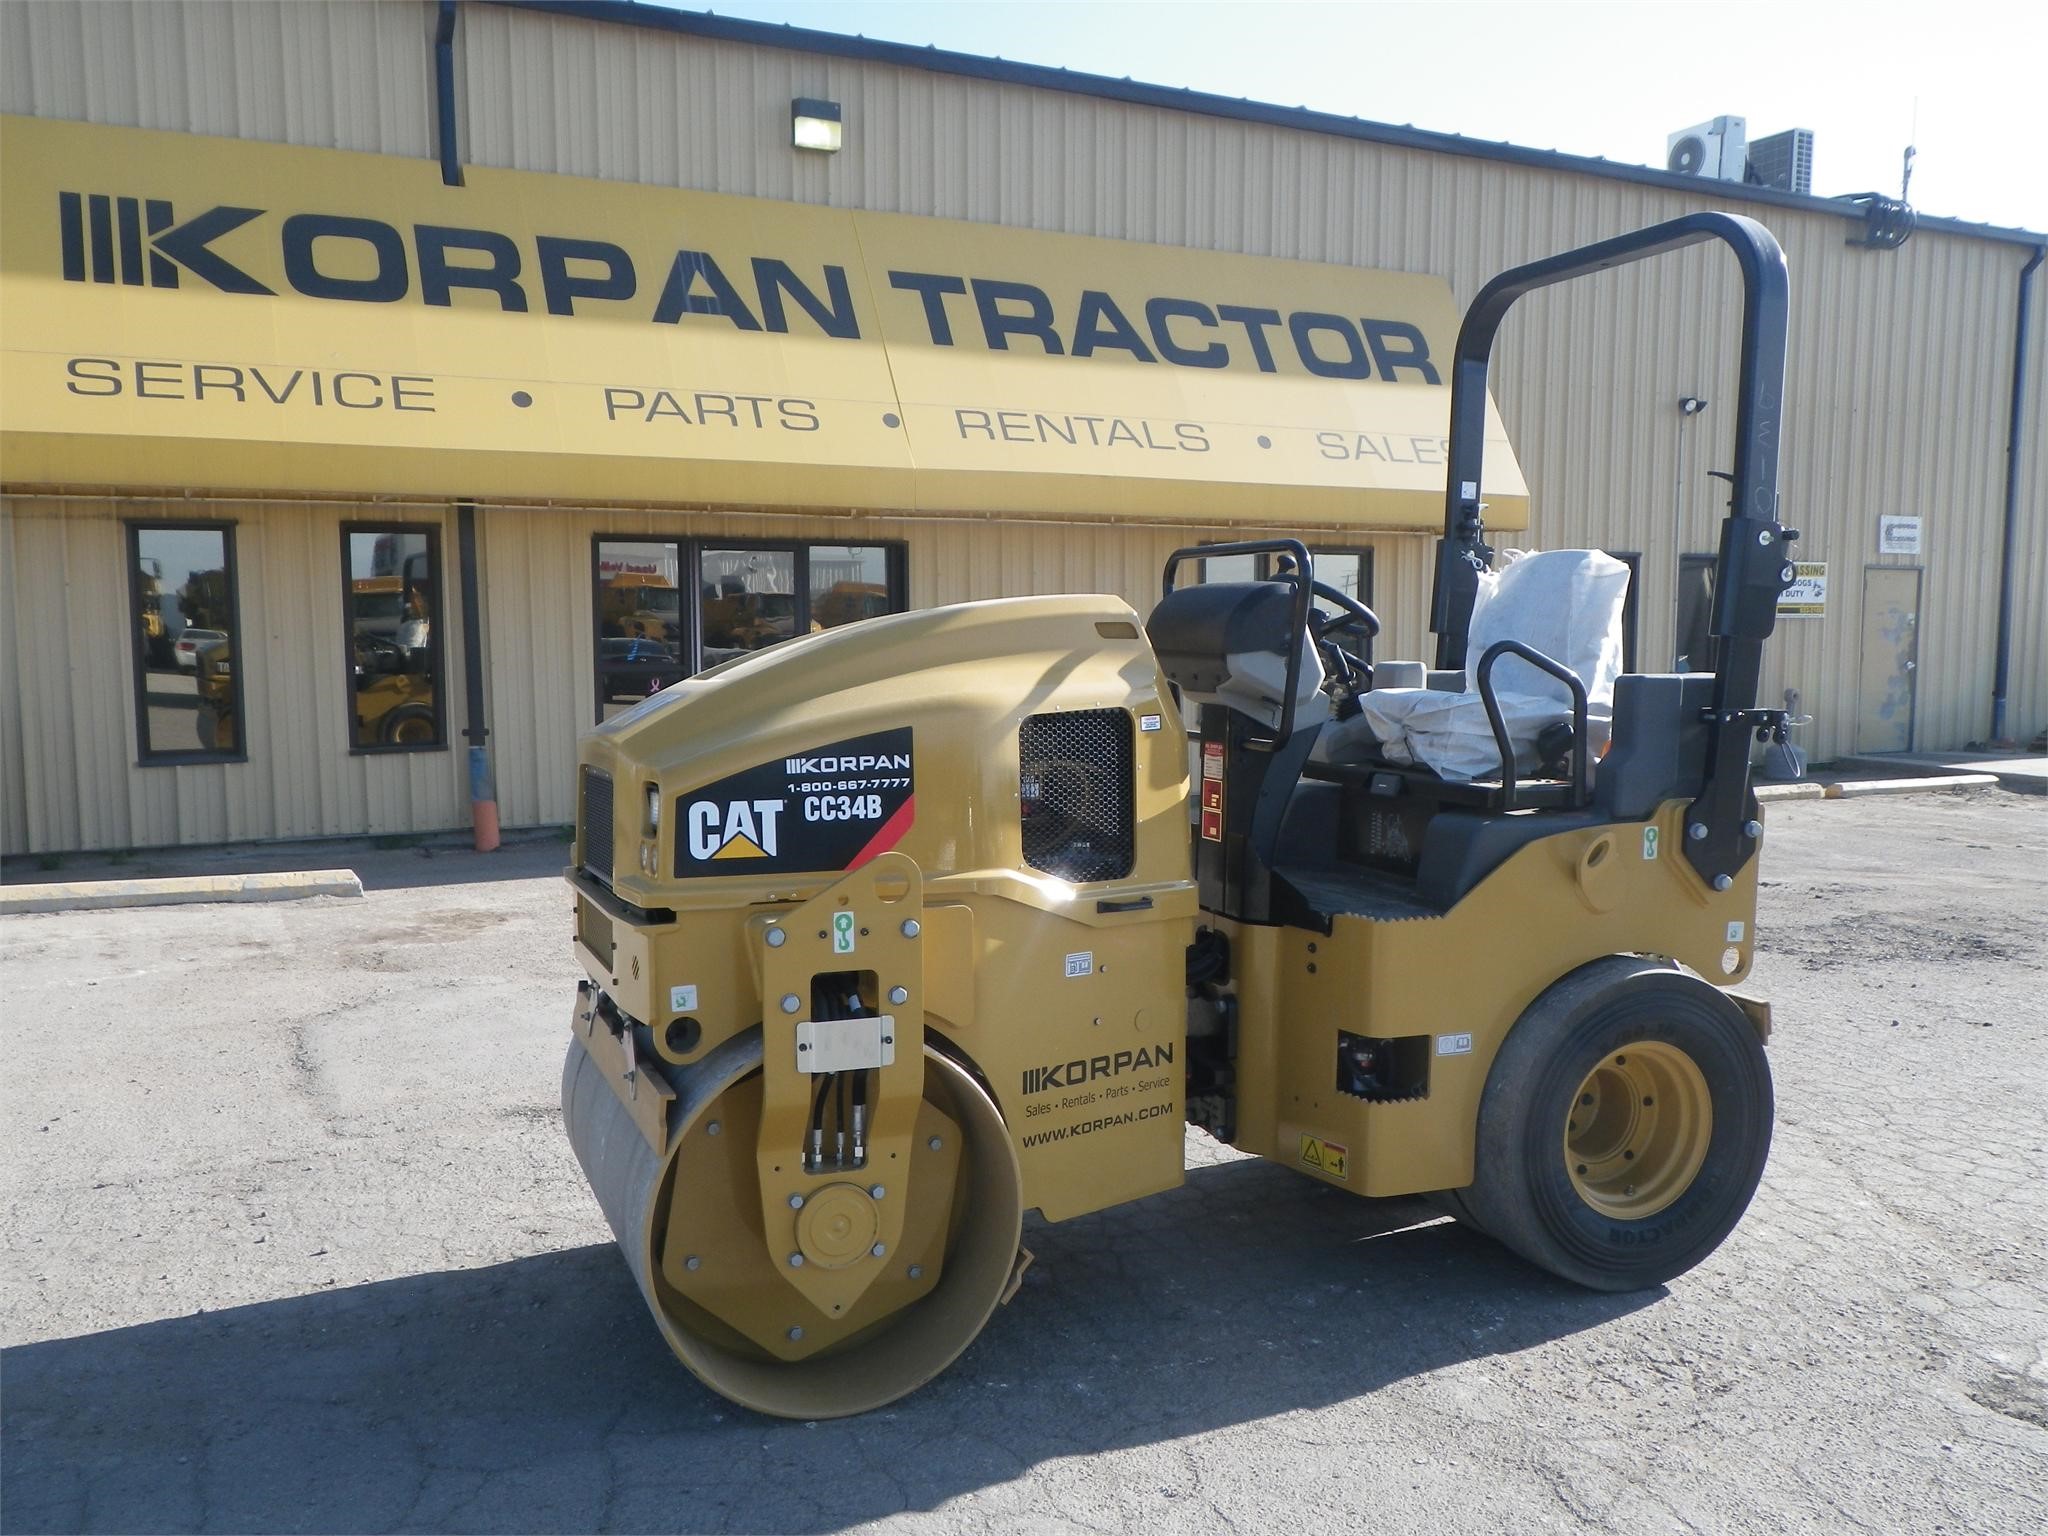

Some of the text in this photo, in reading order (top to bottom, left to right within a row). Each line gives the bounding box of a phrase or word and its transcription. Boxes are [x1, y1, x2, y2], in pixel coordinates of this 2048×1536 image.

[145, 197, 1443, 386] KORPAN TRACTOR
[66, 357, 1449, 465] SERVICE PARTS RENTALS SALE
[787, 778, 910, 793] 1-800-667-7777
[799, 754, 910, 774] KORPAN
[688, 799, 784, 860] CAT
[804, 794, 883, 822] CC34B
[1041, 1042, 1173, 1091] KORPAN
[1026, 1076, 1170, 1118] Sales Rentals Parts Service
[1022, 1103, 1174, 1148] WWW.KORPAN.COM
